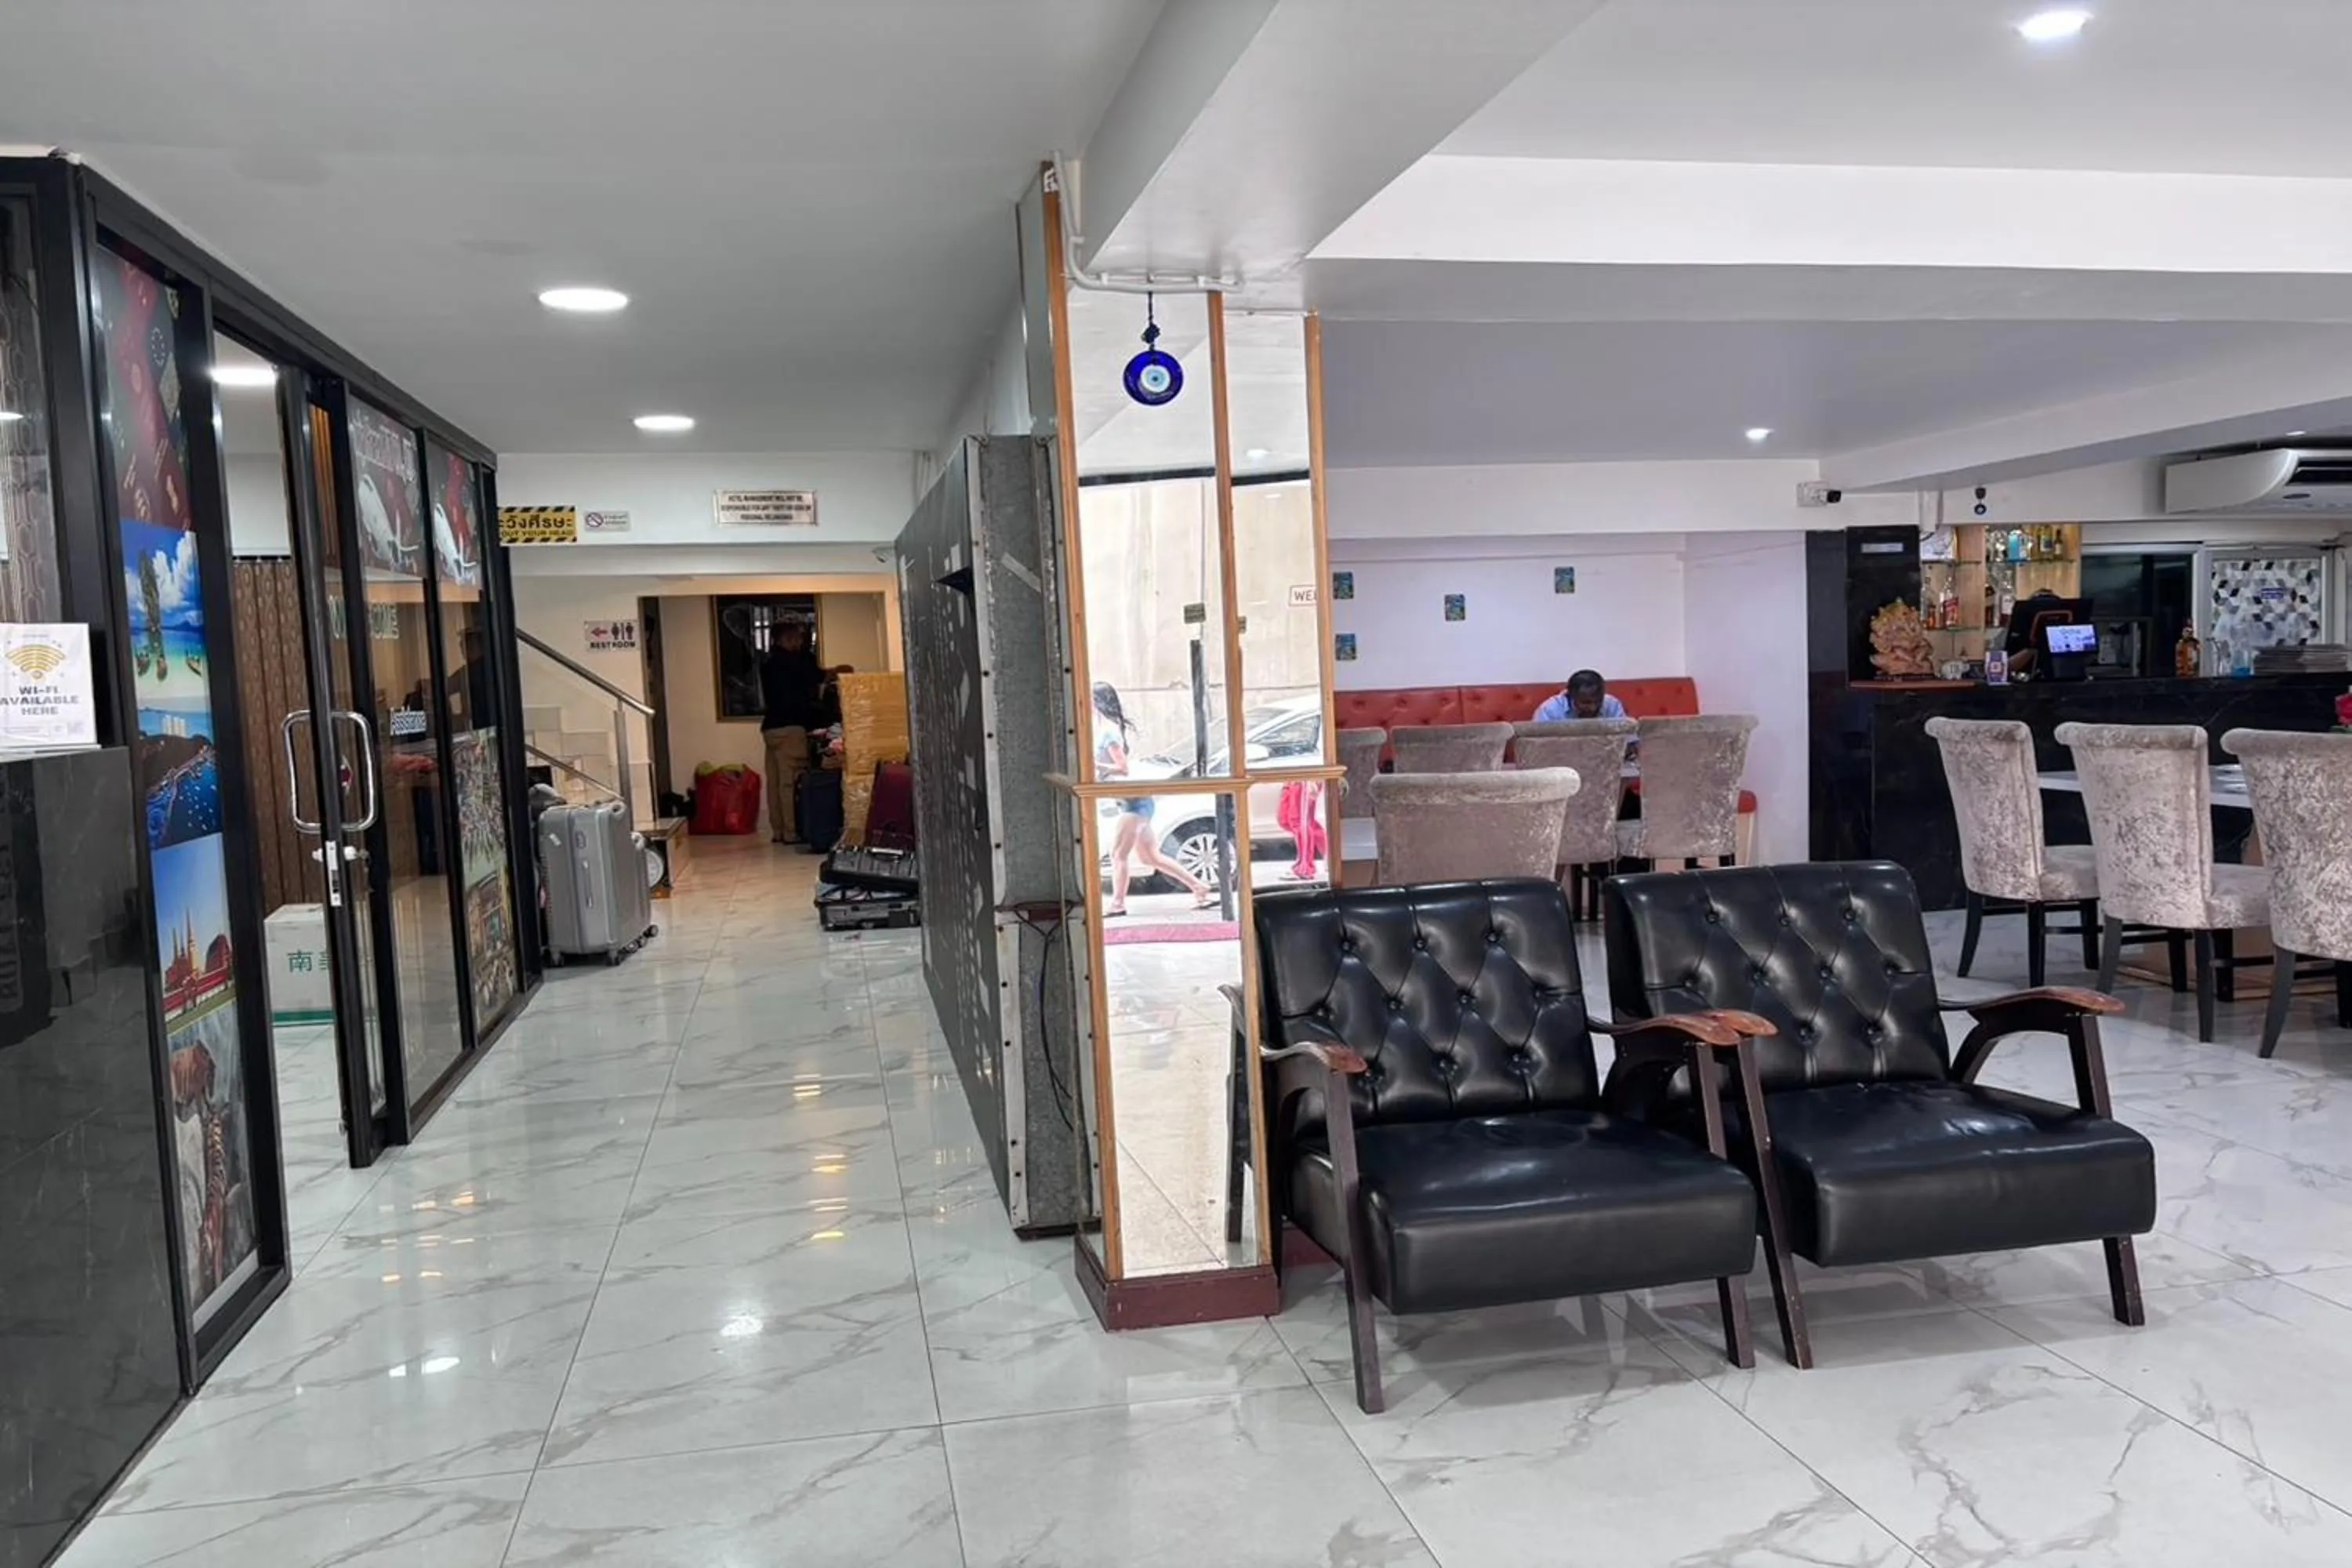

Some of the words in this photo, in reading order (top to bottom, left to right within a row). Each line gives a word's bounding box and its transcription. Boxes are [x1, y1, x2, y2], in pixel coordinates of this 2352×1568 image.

[19, 685, 59, 695] WI-FI
[0, 695, 78, 705] AVAILABLE
[21, 706, 59, 715] HERE
